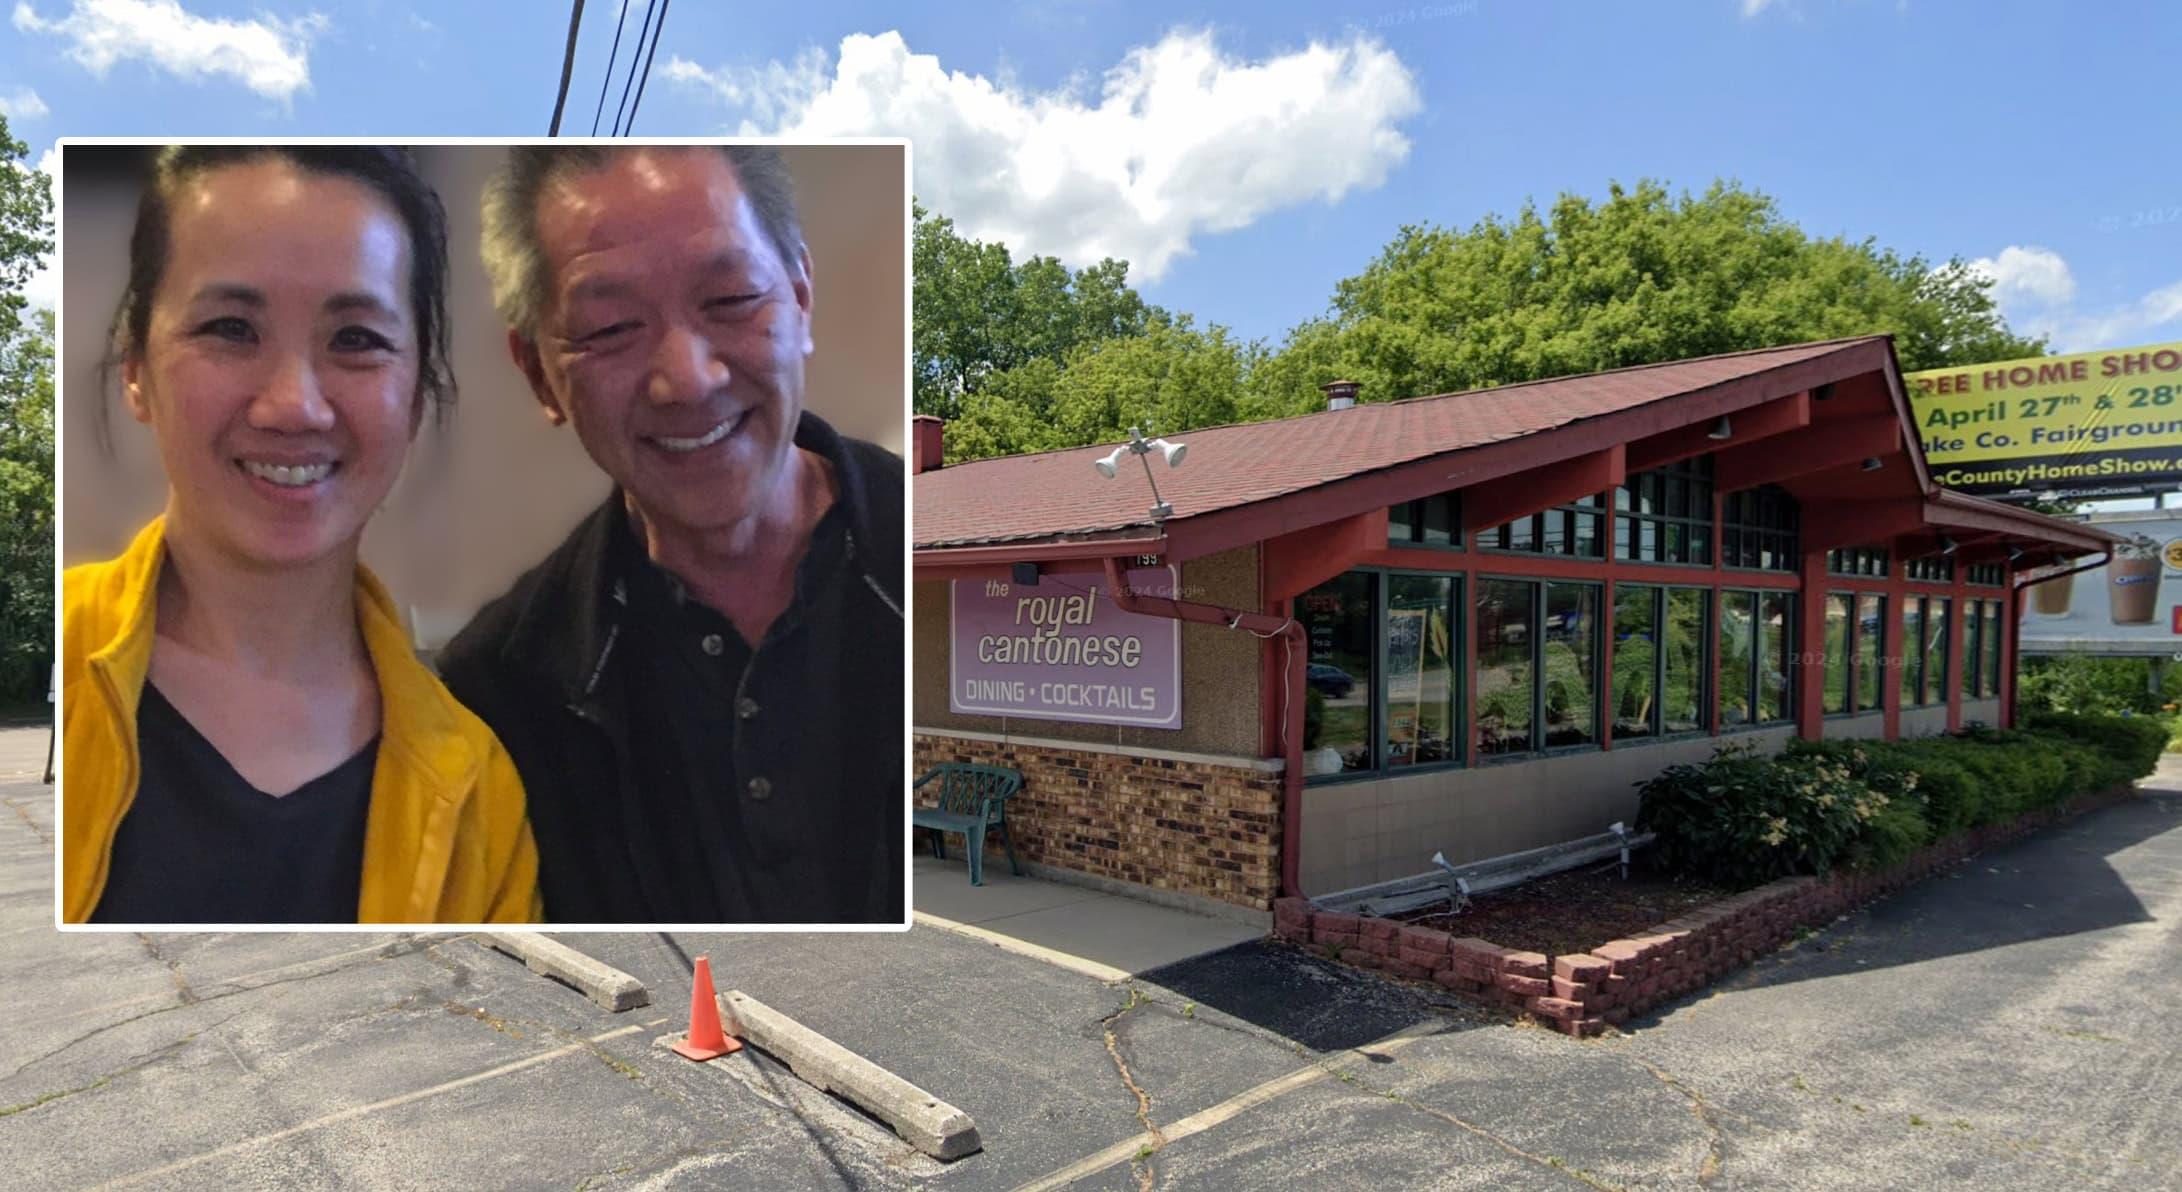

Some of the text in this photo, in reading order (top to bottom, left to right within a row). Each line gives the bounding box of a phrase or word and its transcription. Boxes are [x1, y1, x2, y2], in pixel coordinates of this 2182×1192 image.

[1906, 372, 1971, 397] REE
[1983, 359, 2089, 391] HOME
[1926, 401, 2005, 430] April
[2019, 393, 2081, 419] 27th
[2094, 391, 2114, 411] &
[1976, 432, 2018, 449] Co.
[985, 579, 1009, 598] the
[1015, 586, 1096, 637] royal
[977, 626, 1142, 668] cantonese
[965, 679, 1156, 711] DINING COCKTAILS
